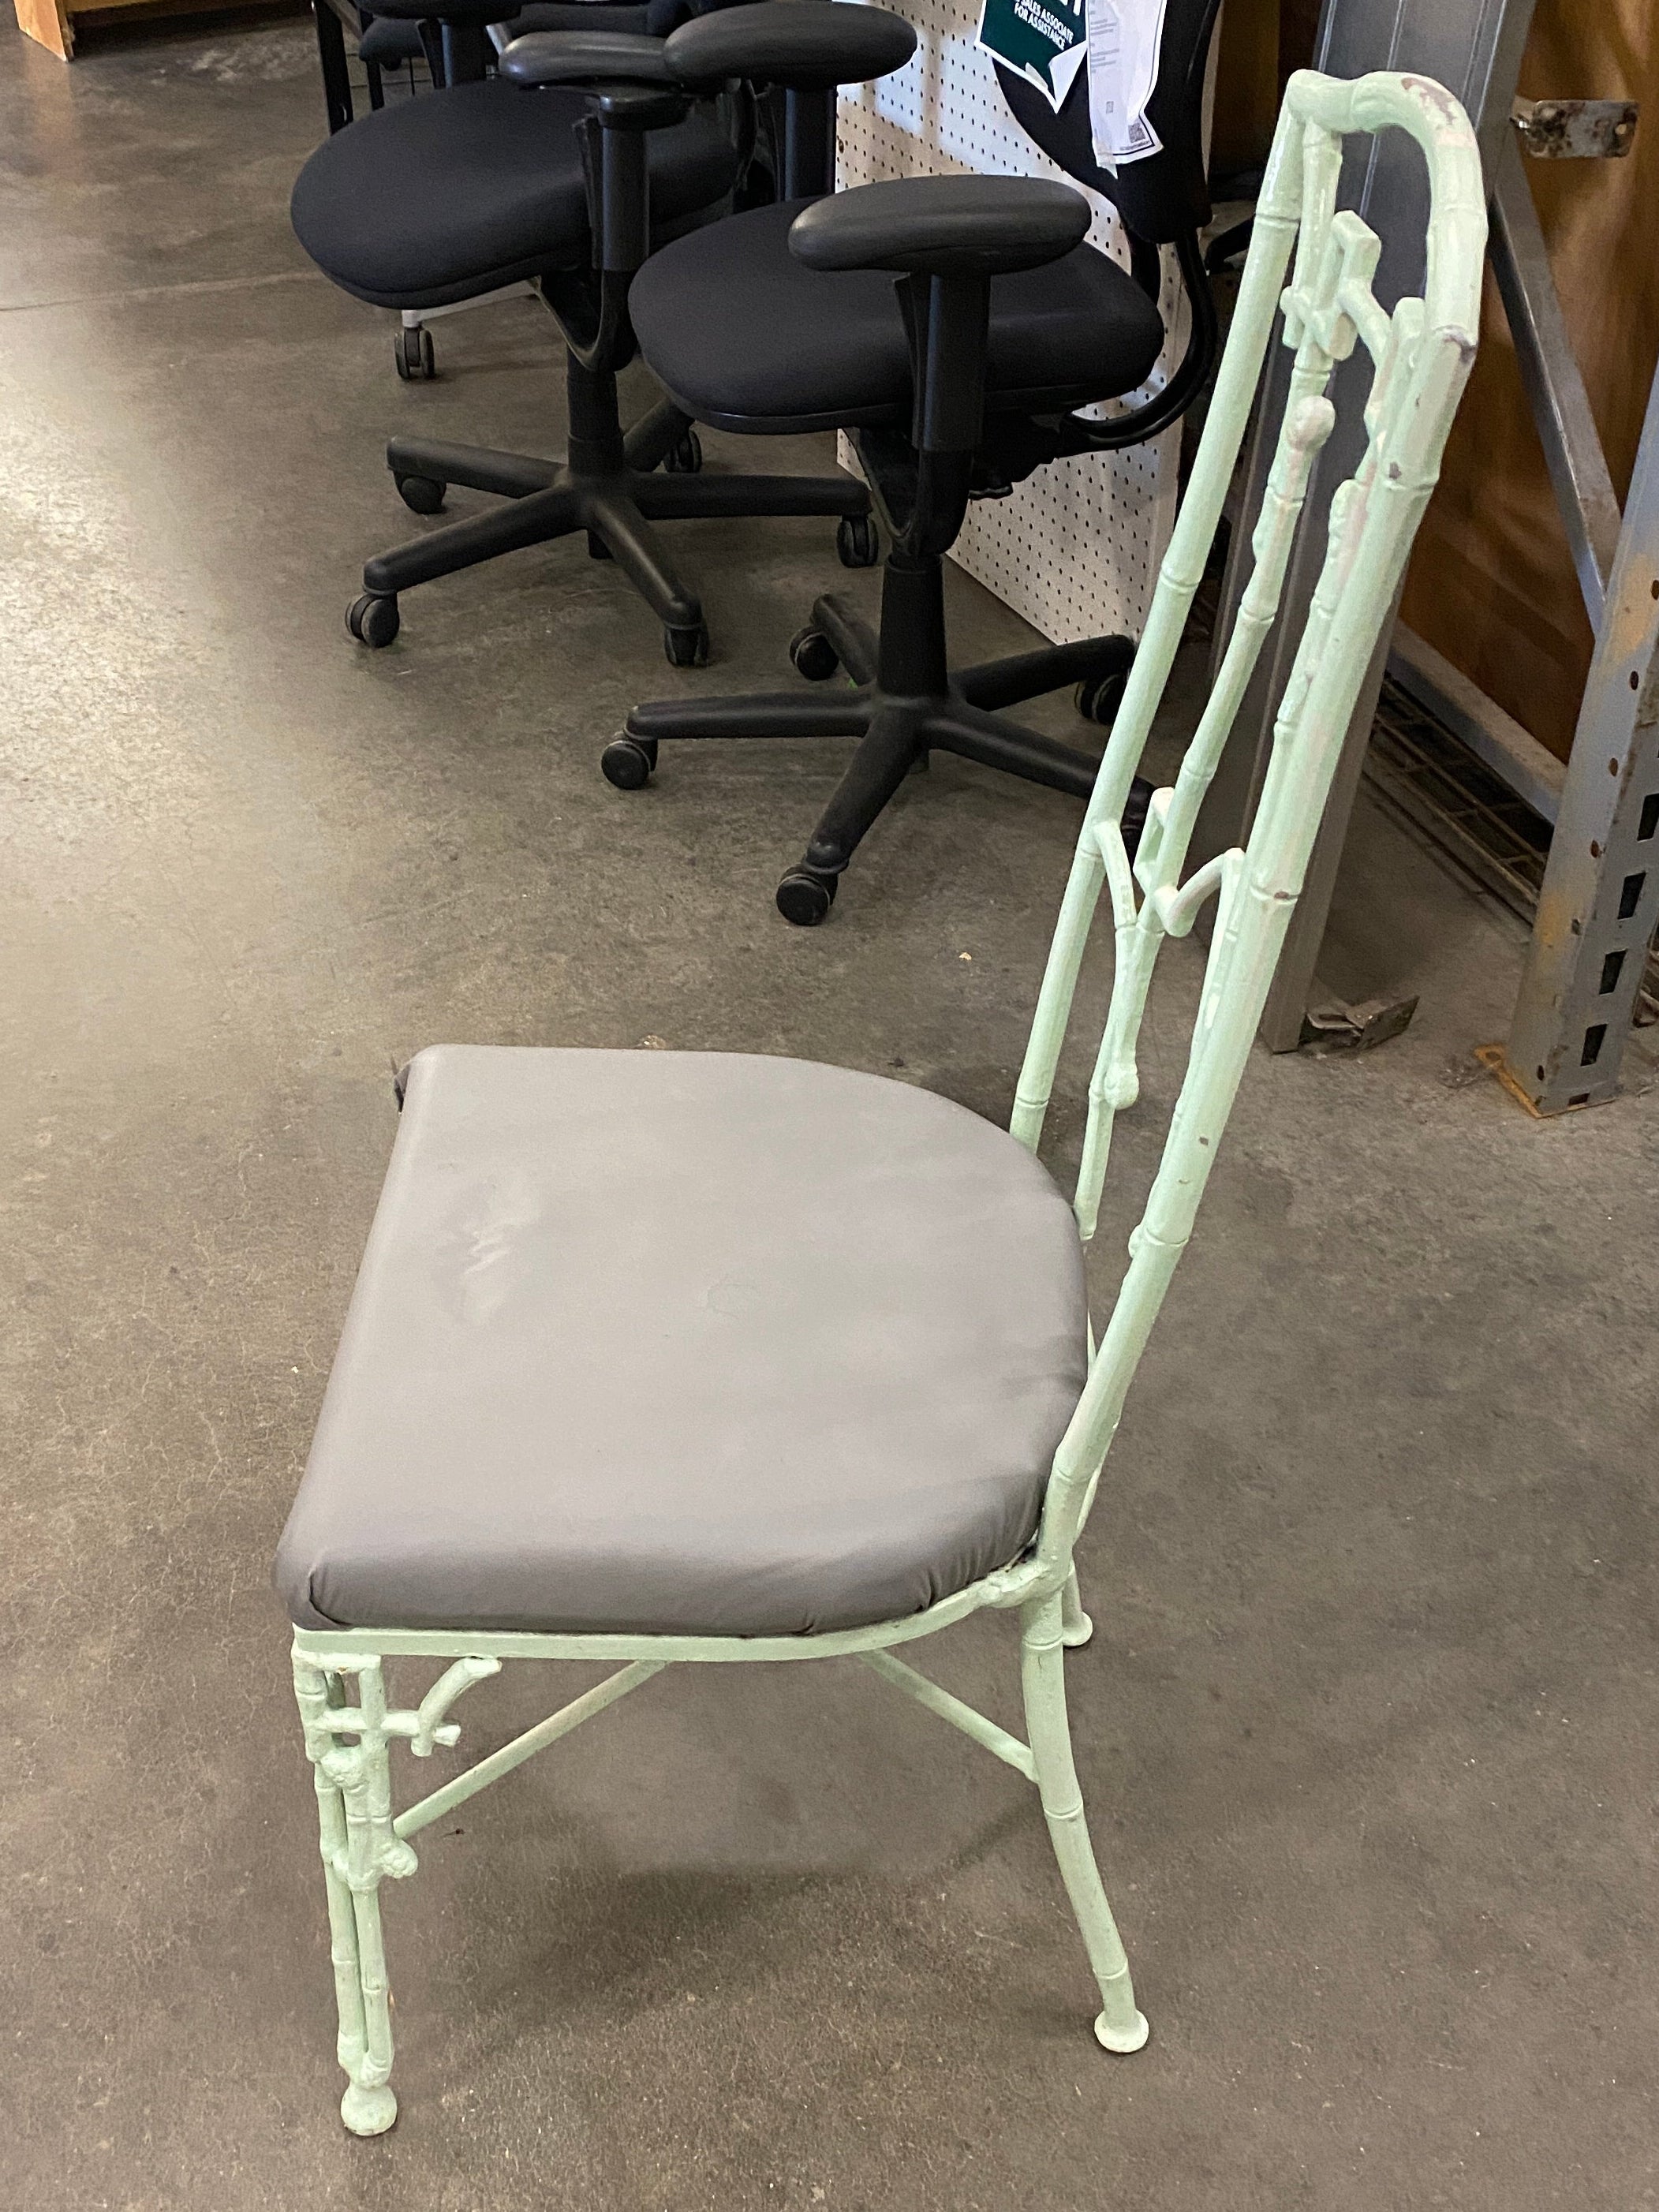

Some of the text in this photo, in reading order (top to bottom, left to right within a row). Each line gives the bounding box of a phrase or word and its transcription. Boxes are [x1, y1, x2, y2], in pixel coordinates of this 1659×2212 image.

[1014, 2, 1028, 22] FOR
[1027, 13, 1066, 51] ASSISTANCE
[1041, 8, 1074, 44] ASSOCIATE
